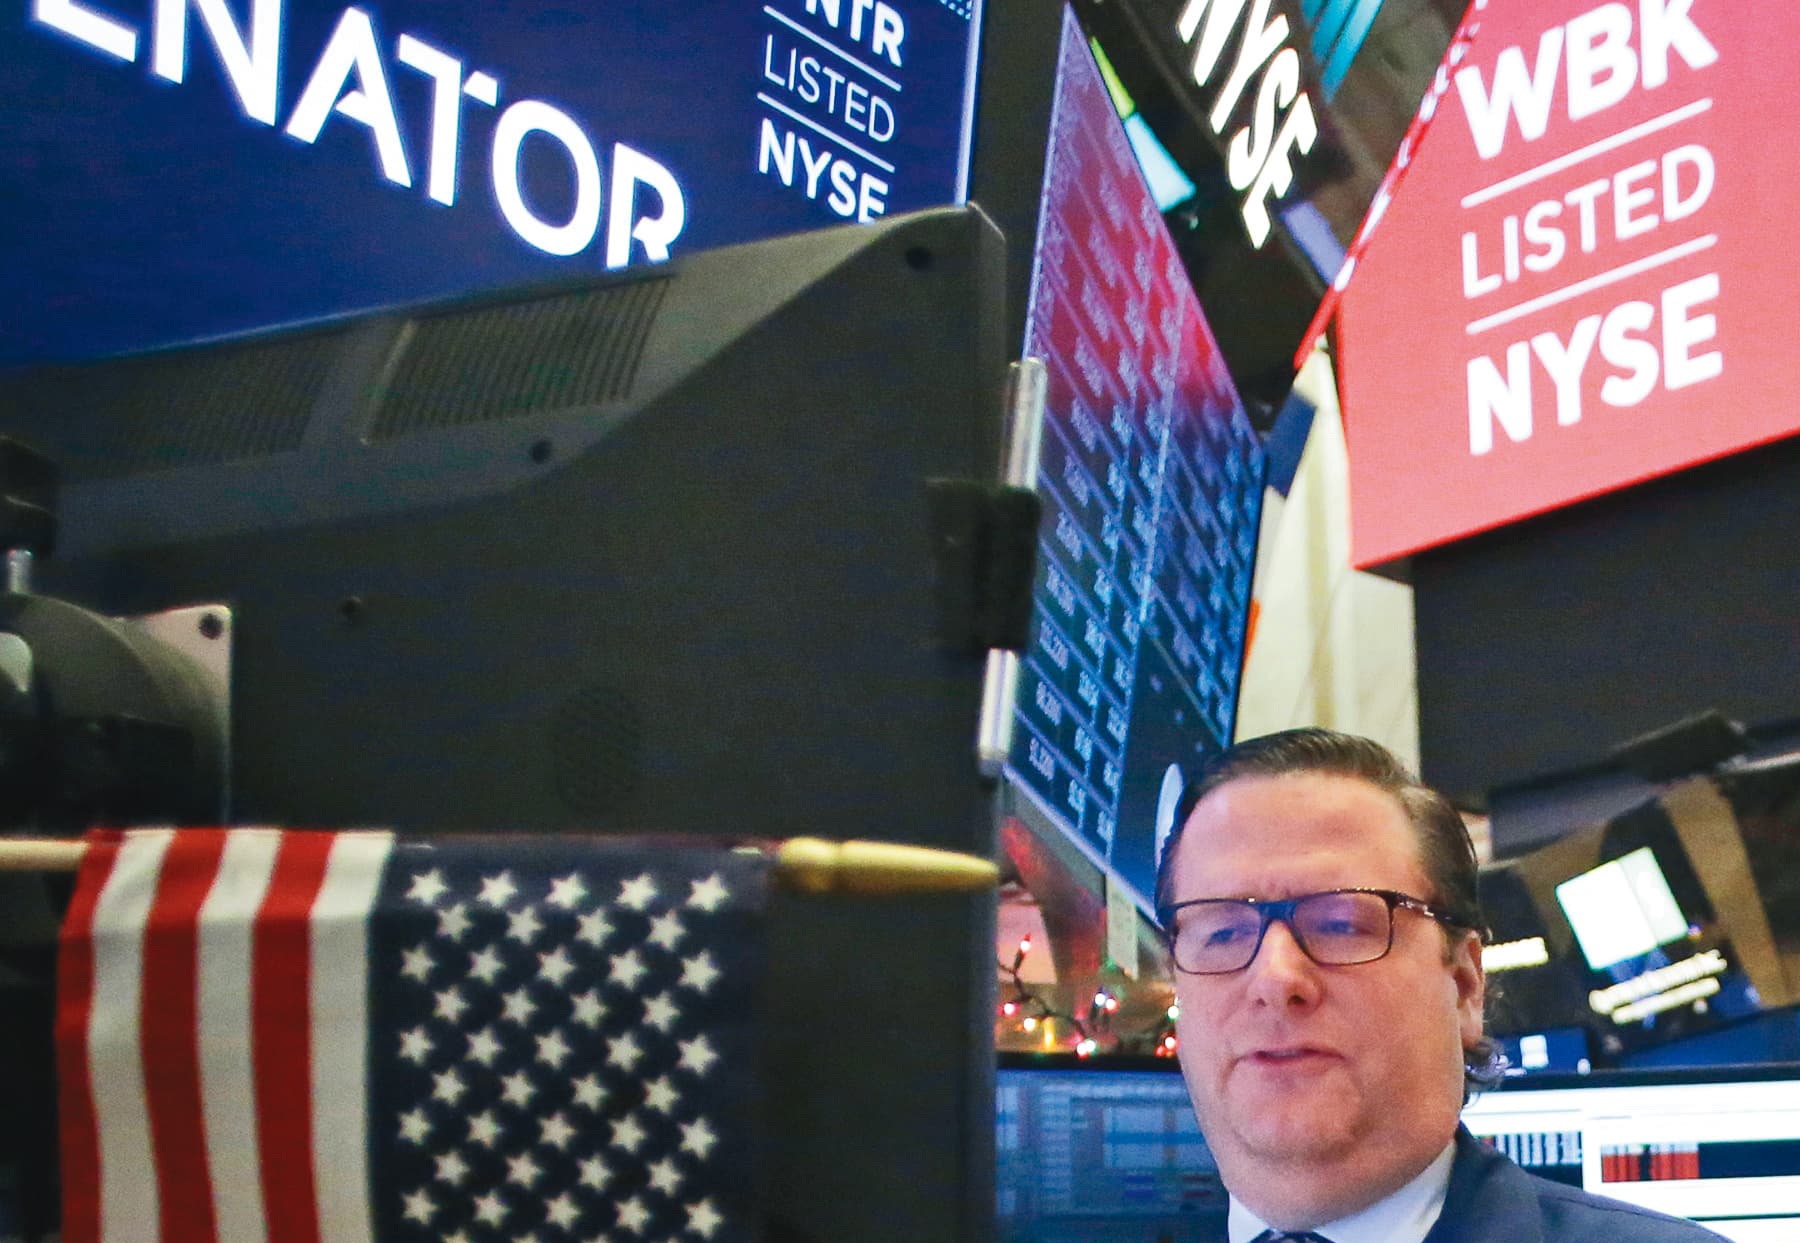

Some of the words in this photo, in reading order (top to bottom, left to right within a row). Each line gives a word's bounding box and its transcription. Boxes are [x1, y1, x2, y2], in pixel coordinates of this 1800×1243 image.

[33, 0, 687, 270] NATOR
[764, 34, 895, 142] LISTED
[1454, 0, 1720, 160] WBK
[758, 117, 889, 225] NYSE
[1461, 144, 1715, 298] LISTED
[1466, 273, 1723, 456] NYSE
